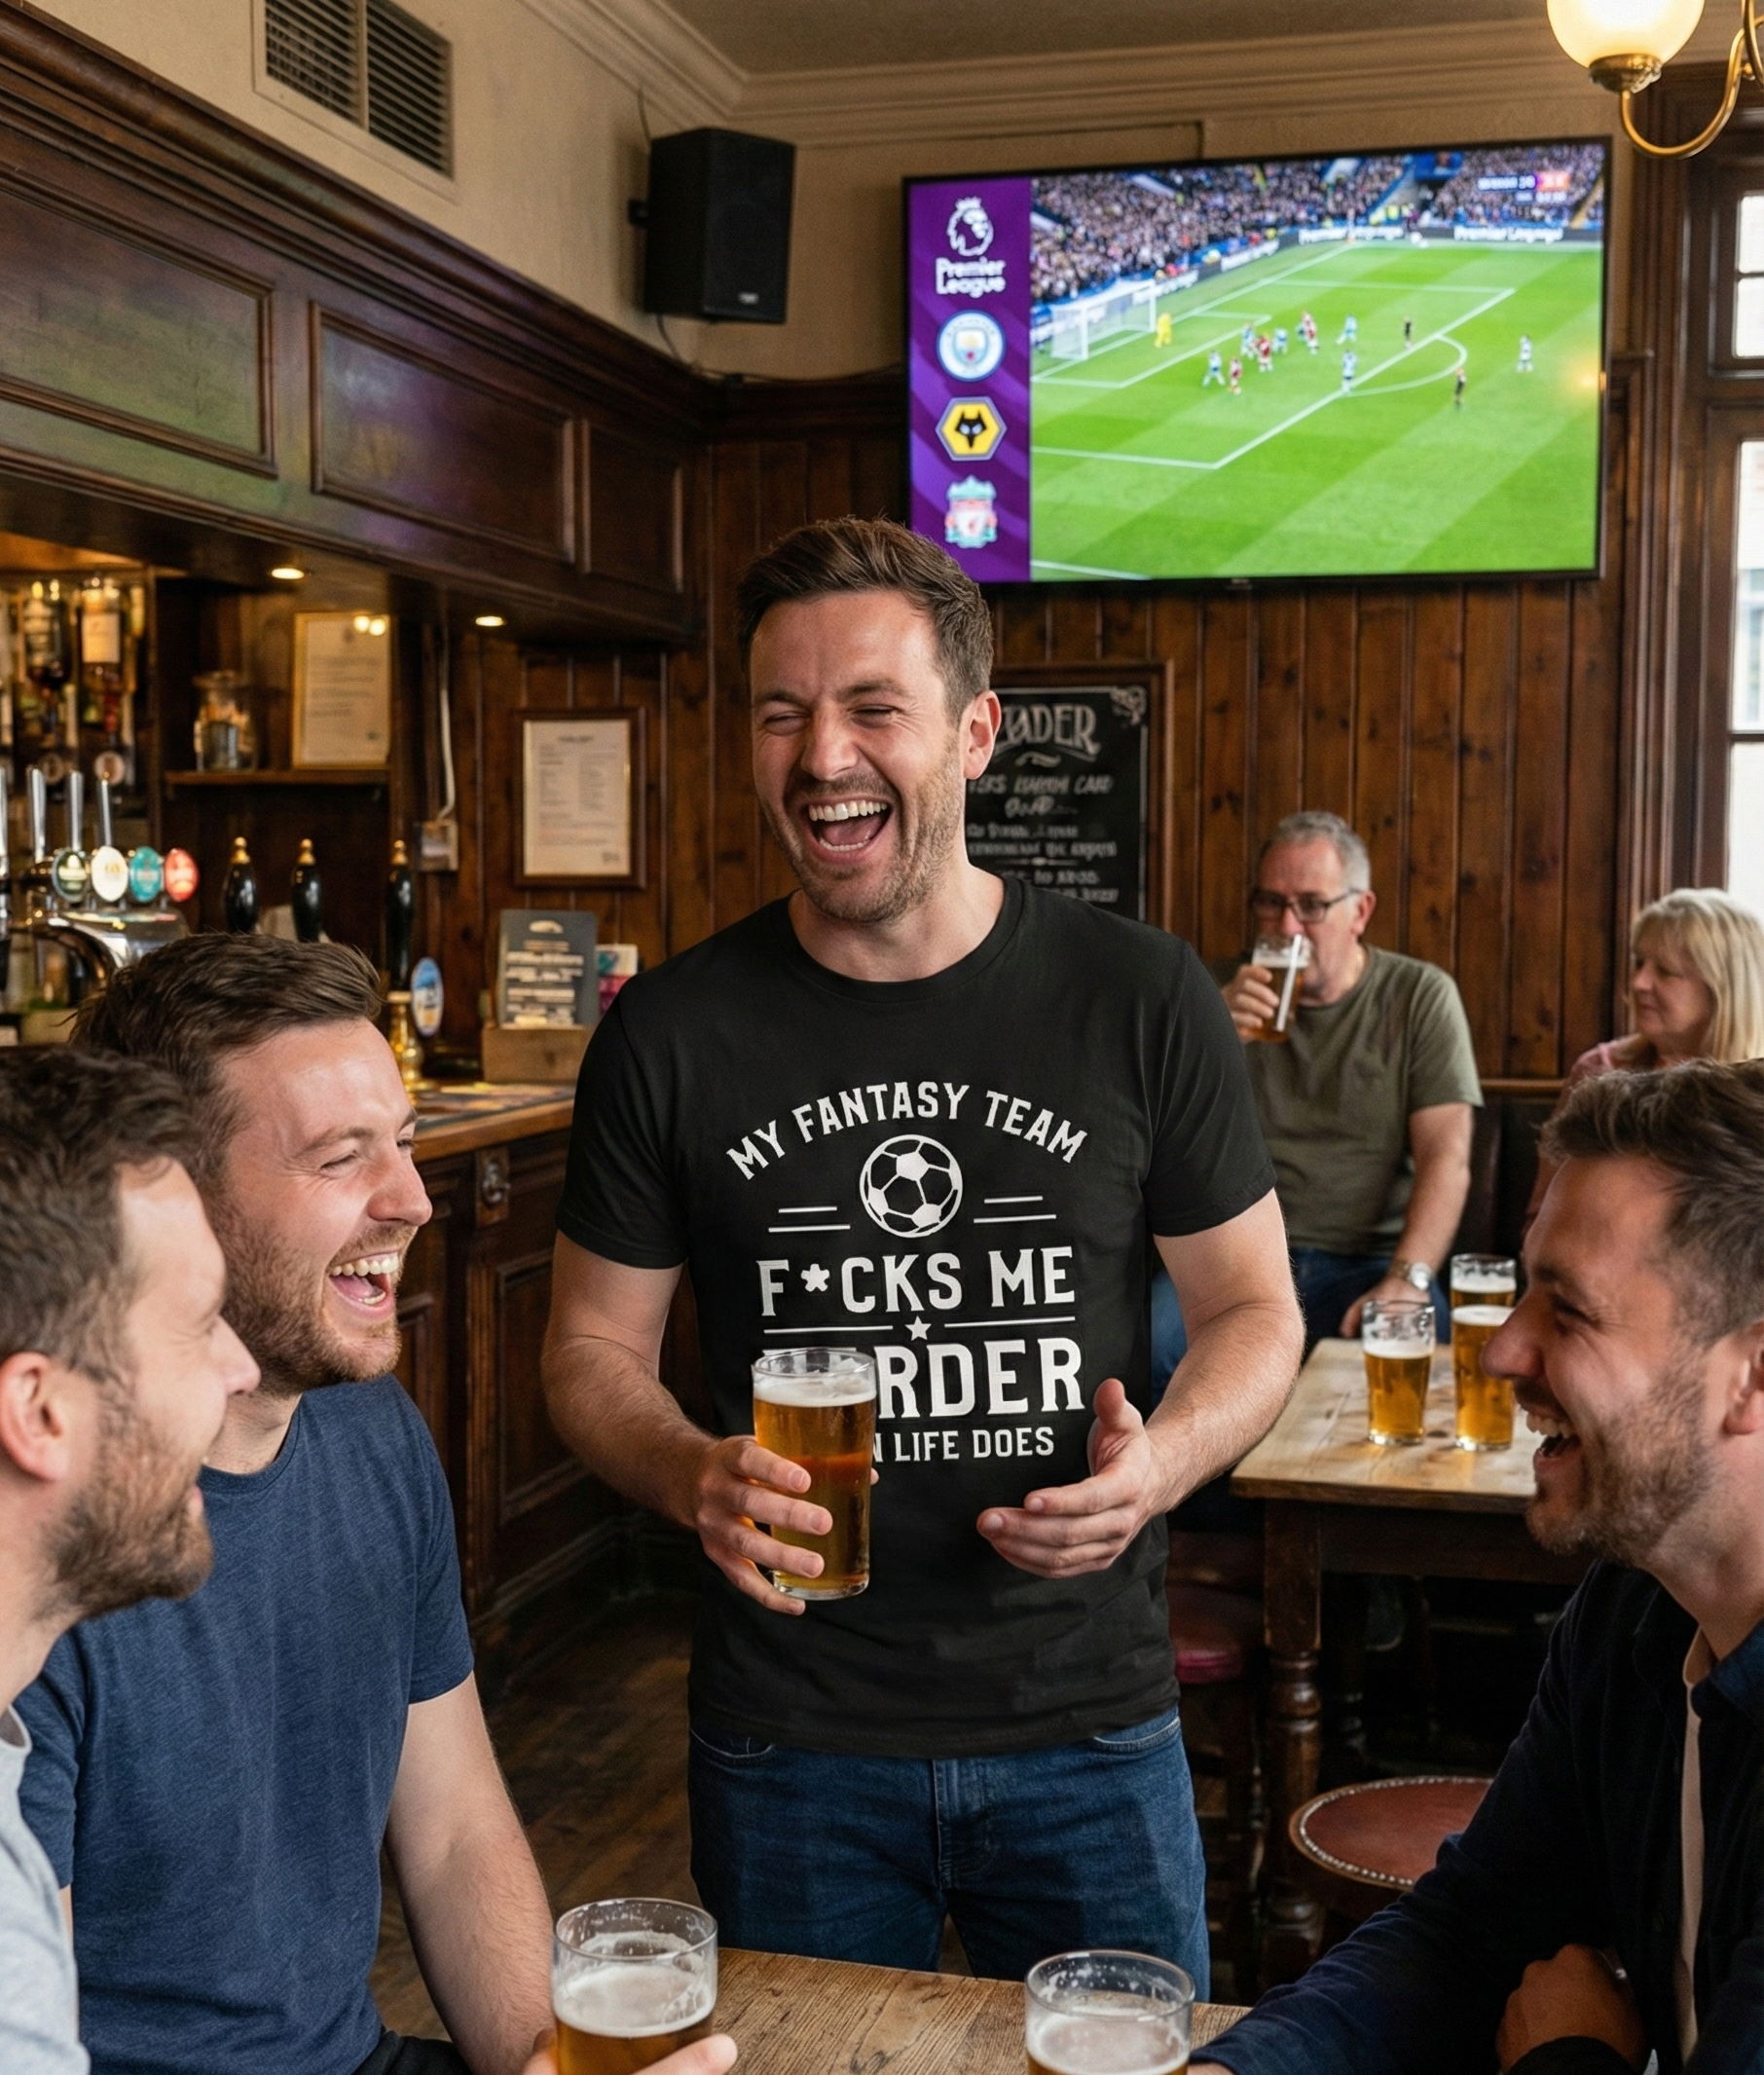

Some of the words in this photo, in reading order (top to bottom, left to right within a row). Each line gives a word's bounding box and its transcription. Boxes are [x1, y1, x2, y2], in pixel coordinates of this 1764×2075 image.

[936, 256, 1007, 278] Premier
[936, 276, 1007, 298] League
[726, 1120, 786, 1180] MY
[791, 1081, 970, 1143] FANTASY
[984, 1090, 1087, 1164] TEAM
[988, 1245, 1076, 1308] ME
[761, 1337, 1085, 1420] RDER
[893, 1429, 960, 1462] LIFE
[973, 1427, 1054, 1459] DOES
